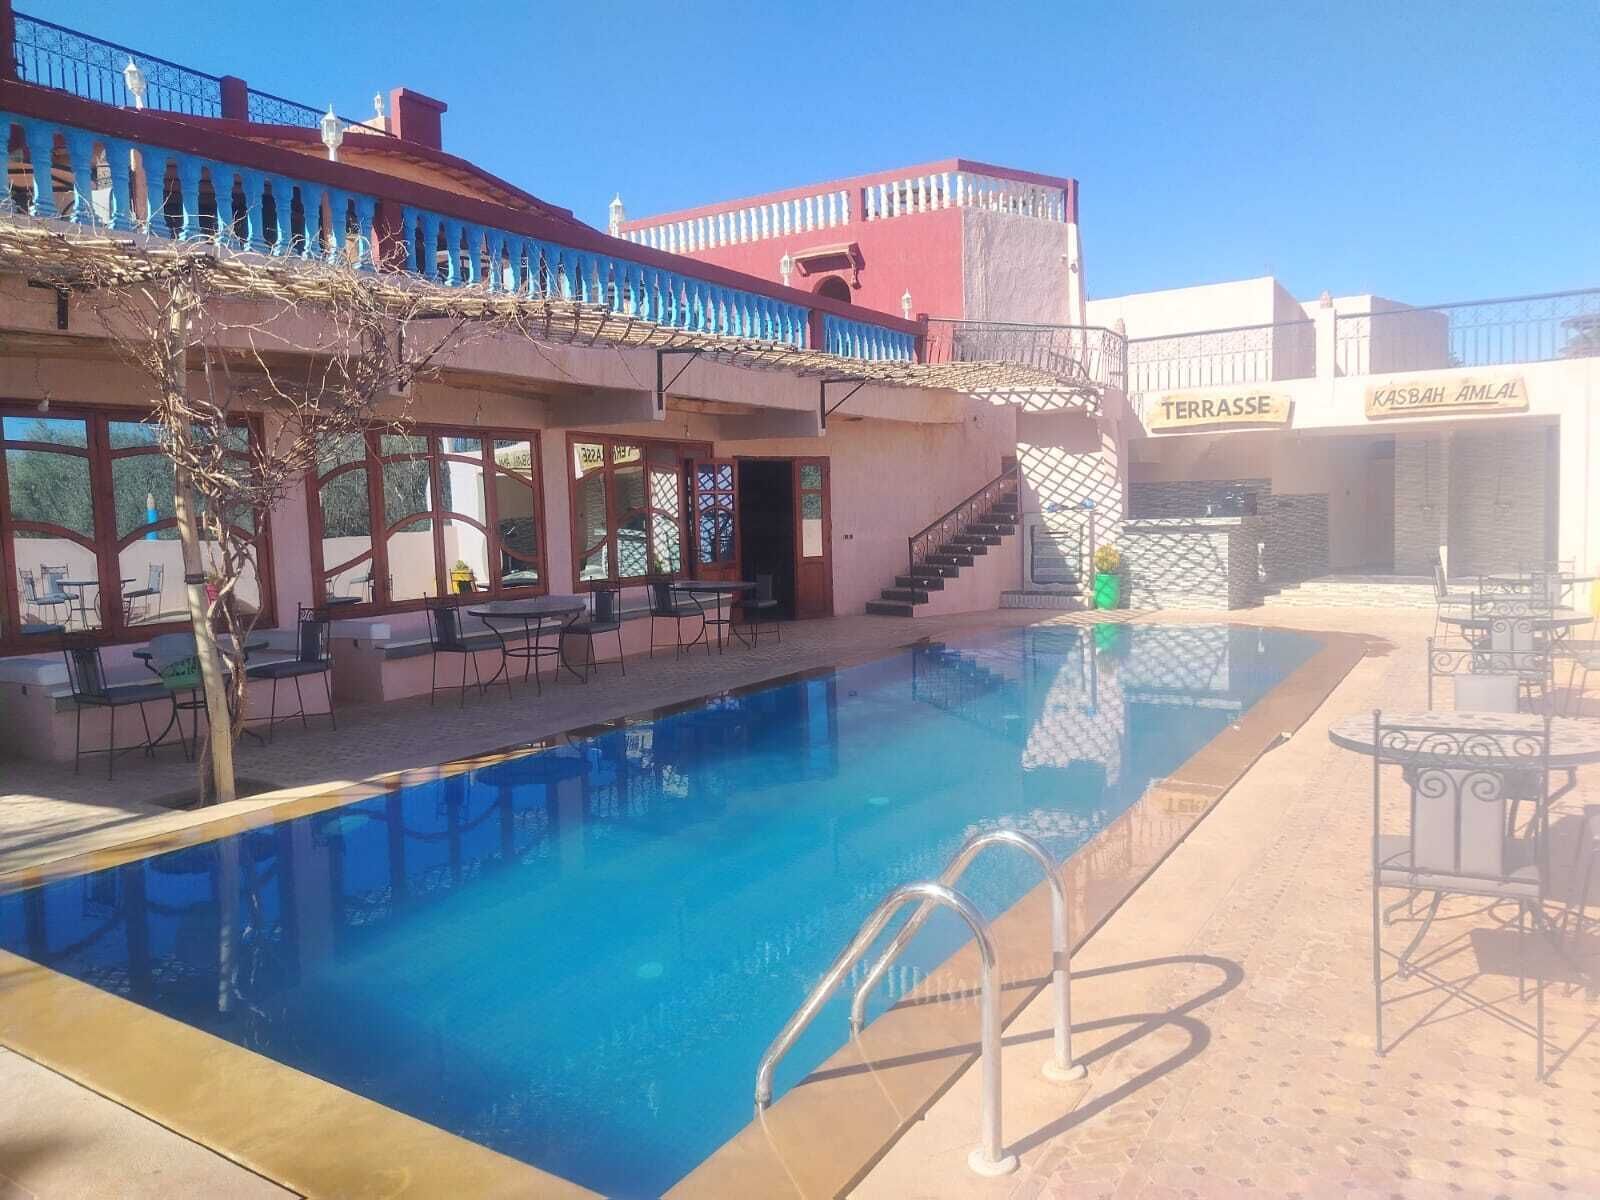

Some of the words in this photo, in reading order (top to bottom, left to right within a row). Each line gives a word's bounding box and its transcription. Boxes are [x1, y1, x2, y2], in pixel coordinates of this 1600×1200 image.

[1372, 386, 1446, 407] KASBAH
[1455, 382, 1520, 402] AMLAL
[1161, 395, 1271, 420] TERRASSE
